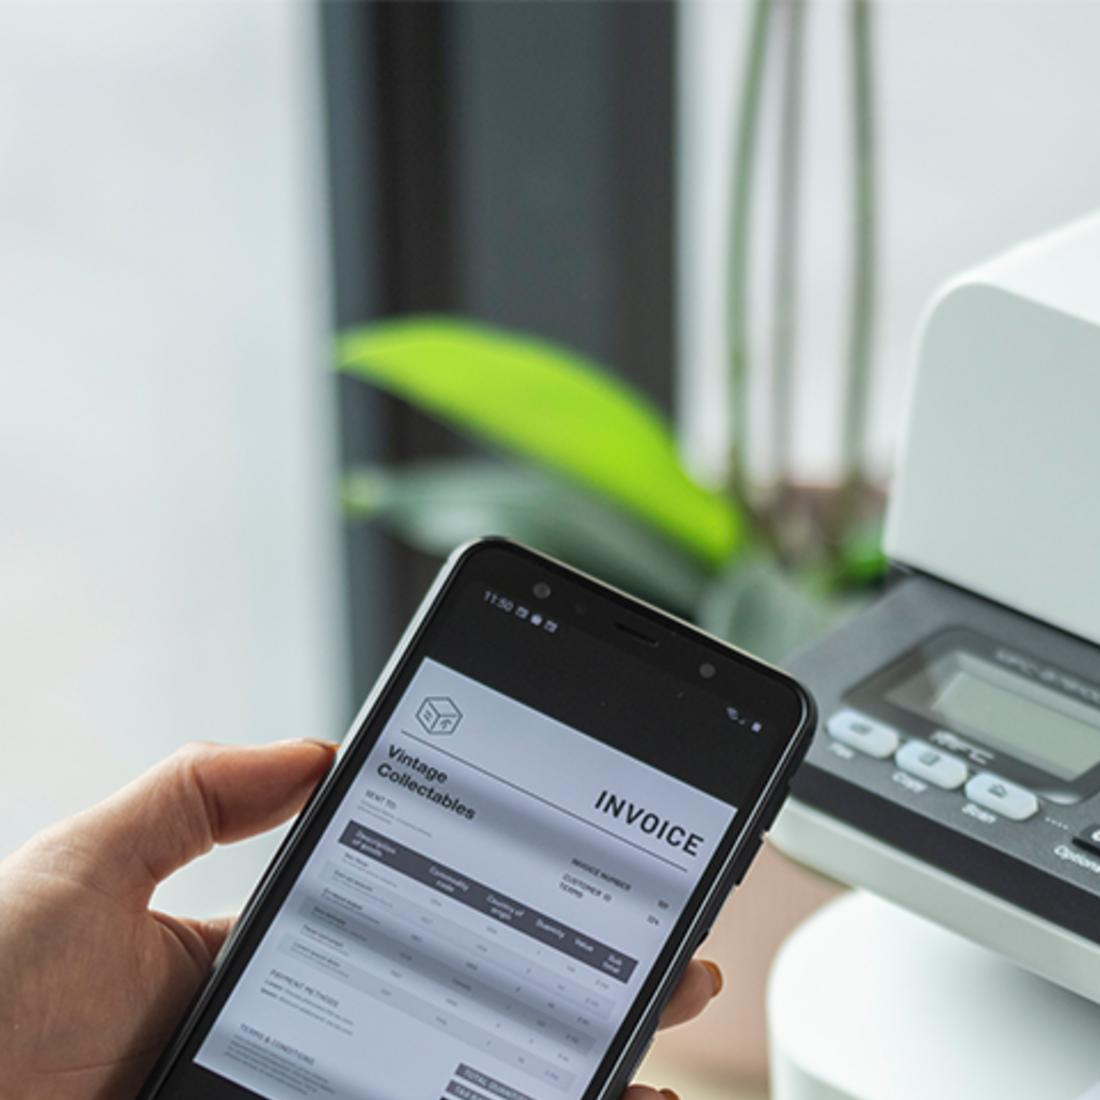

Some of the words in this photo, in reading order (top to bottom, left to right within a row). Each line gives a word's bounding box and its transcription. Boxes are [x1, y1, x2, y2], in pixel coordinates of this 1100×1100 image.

[484, 591, 514, 612] 11:50
[387, 744, 448, 784] Vintage
[376, 762, 477, 822] Collectables
[594, 790, 704, 857] INVOICE
[961, 803, 997, 824] Scan
